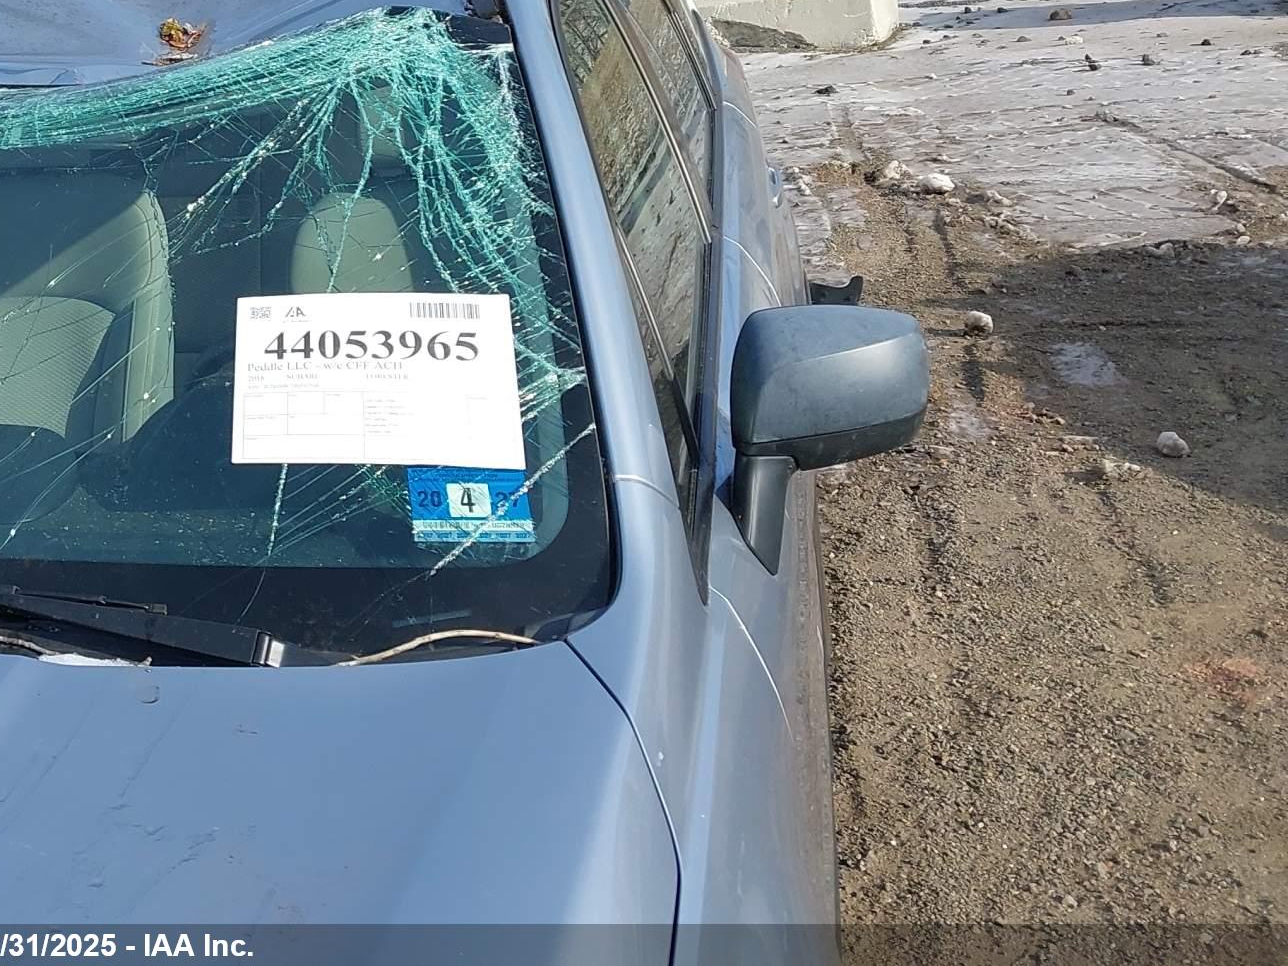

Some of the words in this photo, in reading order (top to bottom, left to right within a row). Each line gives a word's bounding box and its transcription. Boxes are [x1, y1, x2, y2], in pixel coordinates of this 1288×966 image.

[264, 330, 479, 362] 44053965
[247, 362, 284, 372] Peddle
[287, 361, 312, 371] LLC
[417, 490, 443, 508] 20
[460, 487, 476, 513] 4
